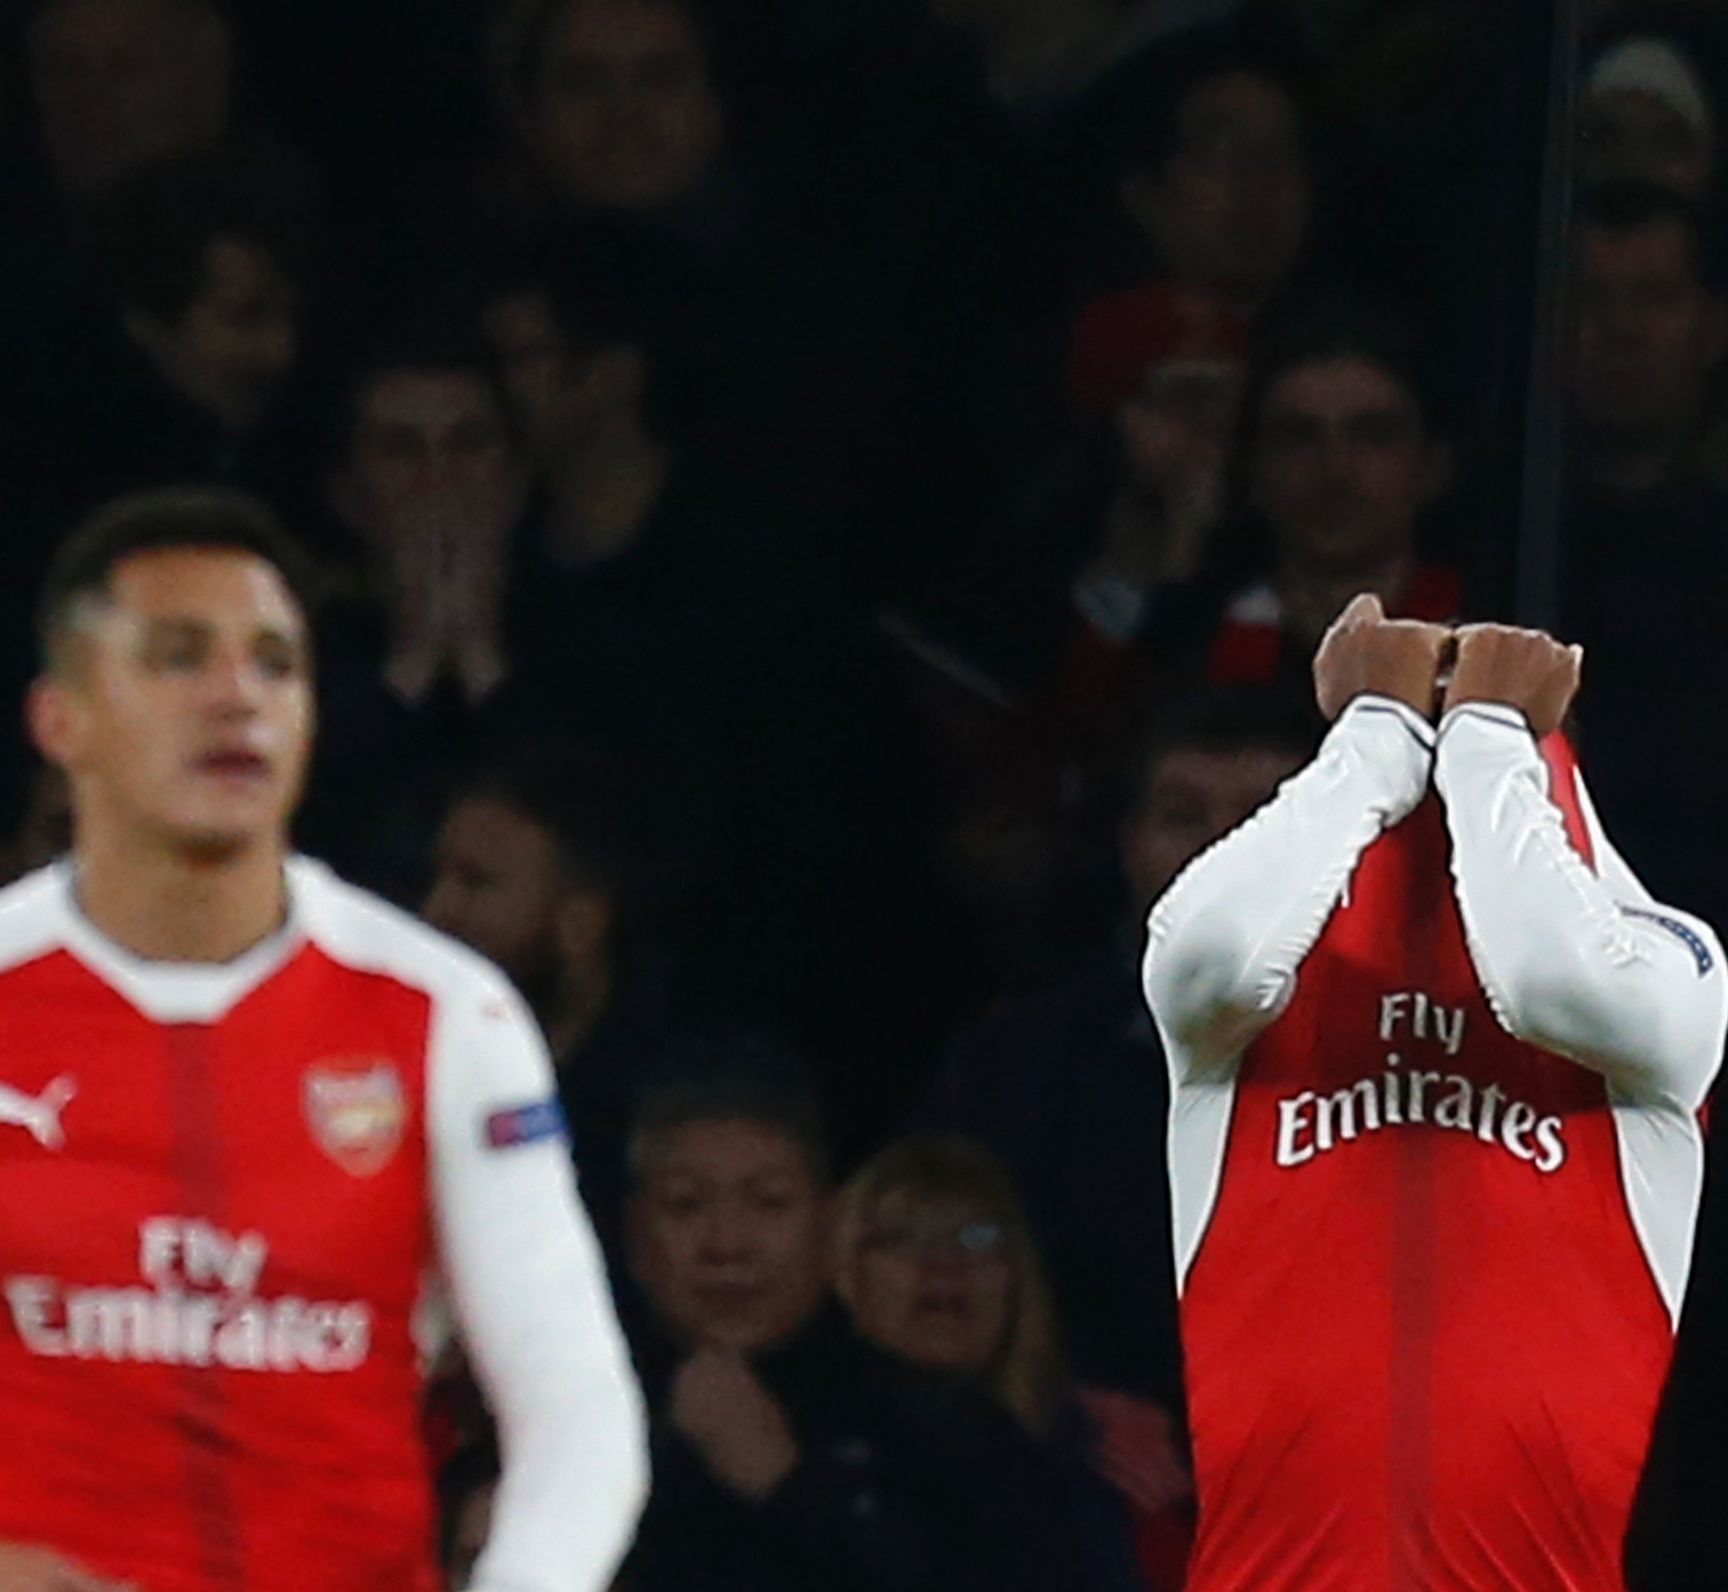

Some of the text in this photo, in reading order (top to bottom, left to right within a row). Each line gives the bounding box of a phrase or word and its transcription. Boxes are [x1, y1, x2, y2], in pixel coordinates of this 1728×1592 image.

[1380, 992, 1465, 1055] Fly
[1276, 1053, 1564, 1172] Emirates
[139, 1214, 266, 1291] Fly
[3, 1273, 373, 1373] Emirates
